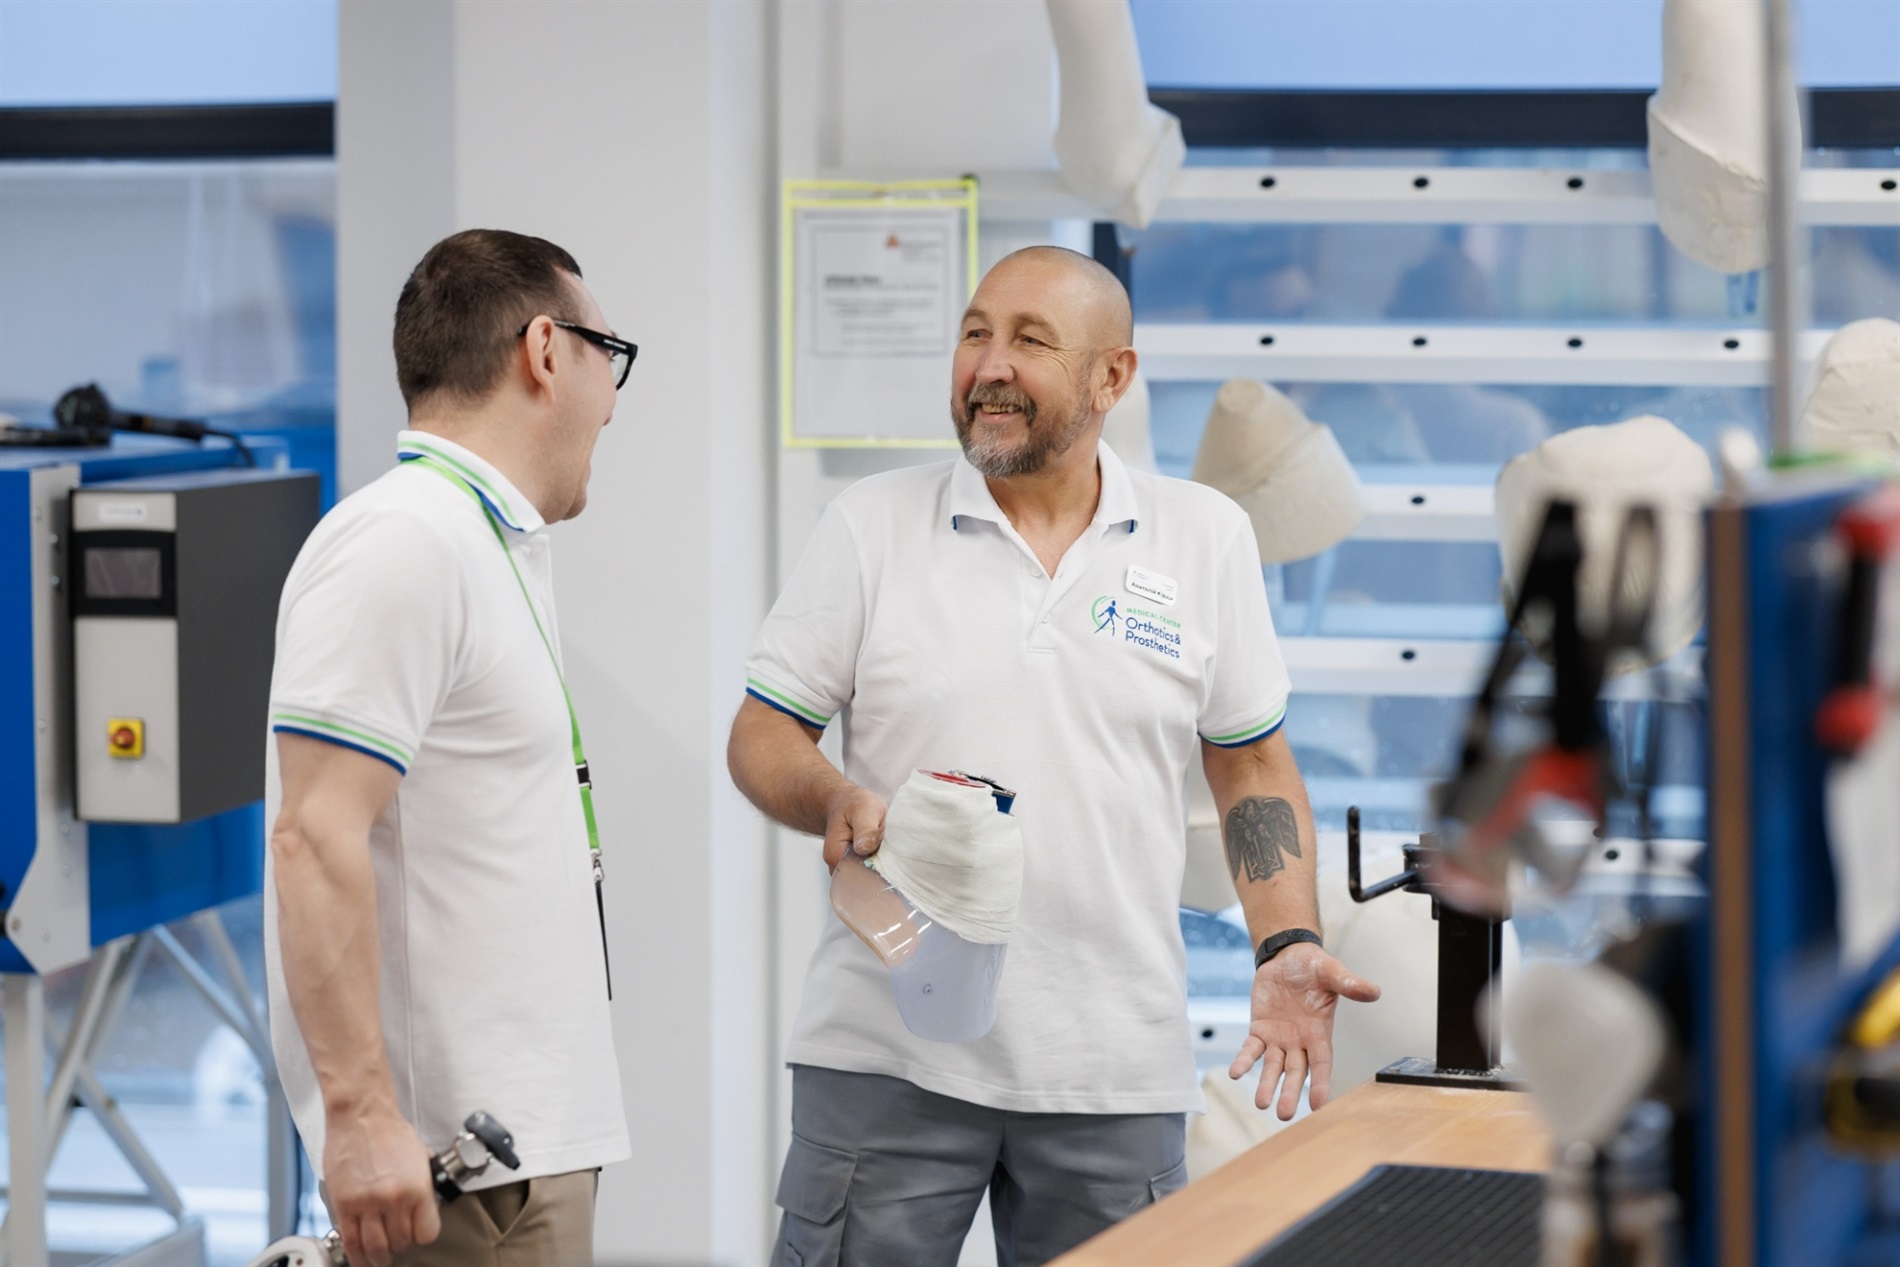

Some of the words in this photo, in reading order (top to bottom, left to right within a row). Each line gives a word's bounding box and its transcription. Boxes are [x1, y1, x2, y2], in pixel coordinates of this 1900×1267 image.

[1126, 607, 1158, 620] MEDICAL
[1159, 615, 1181, 628] CENTER
[1125, 630, 1180, 658] Prosthetics
